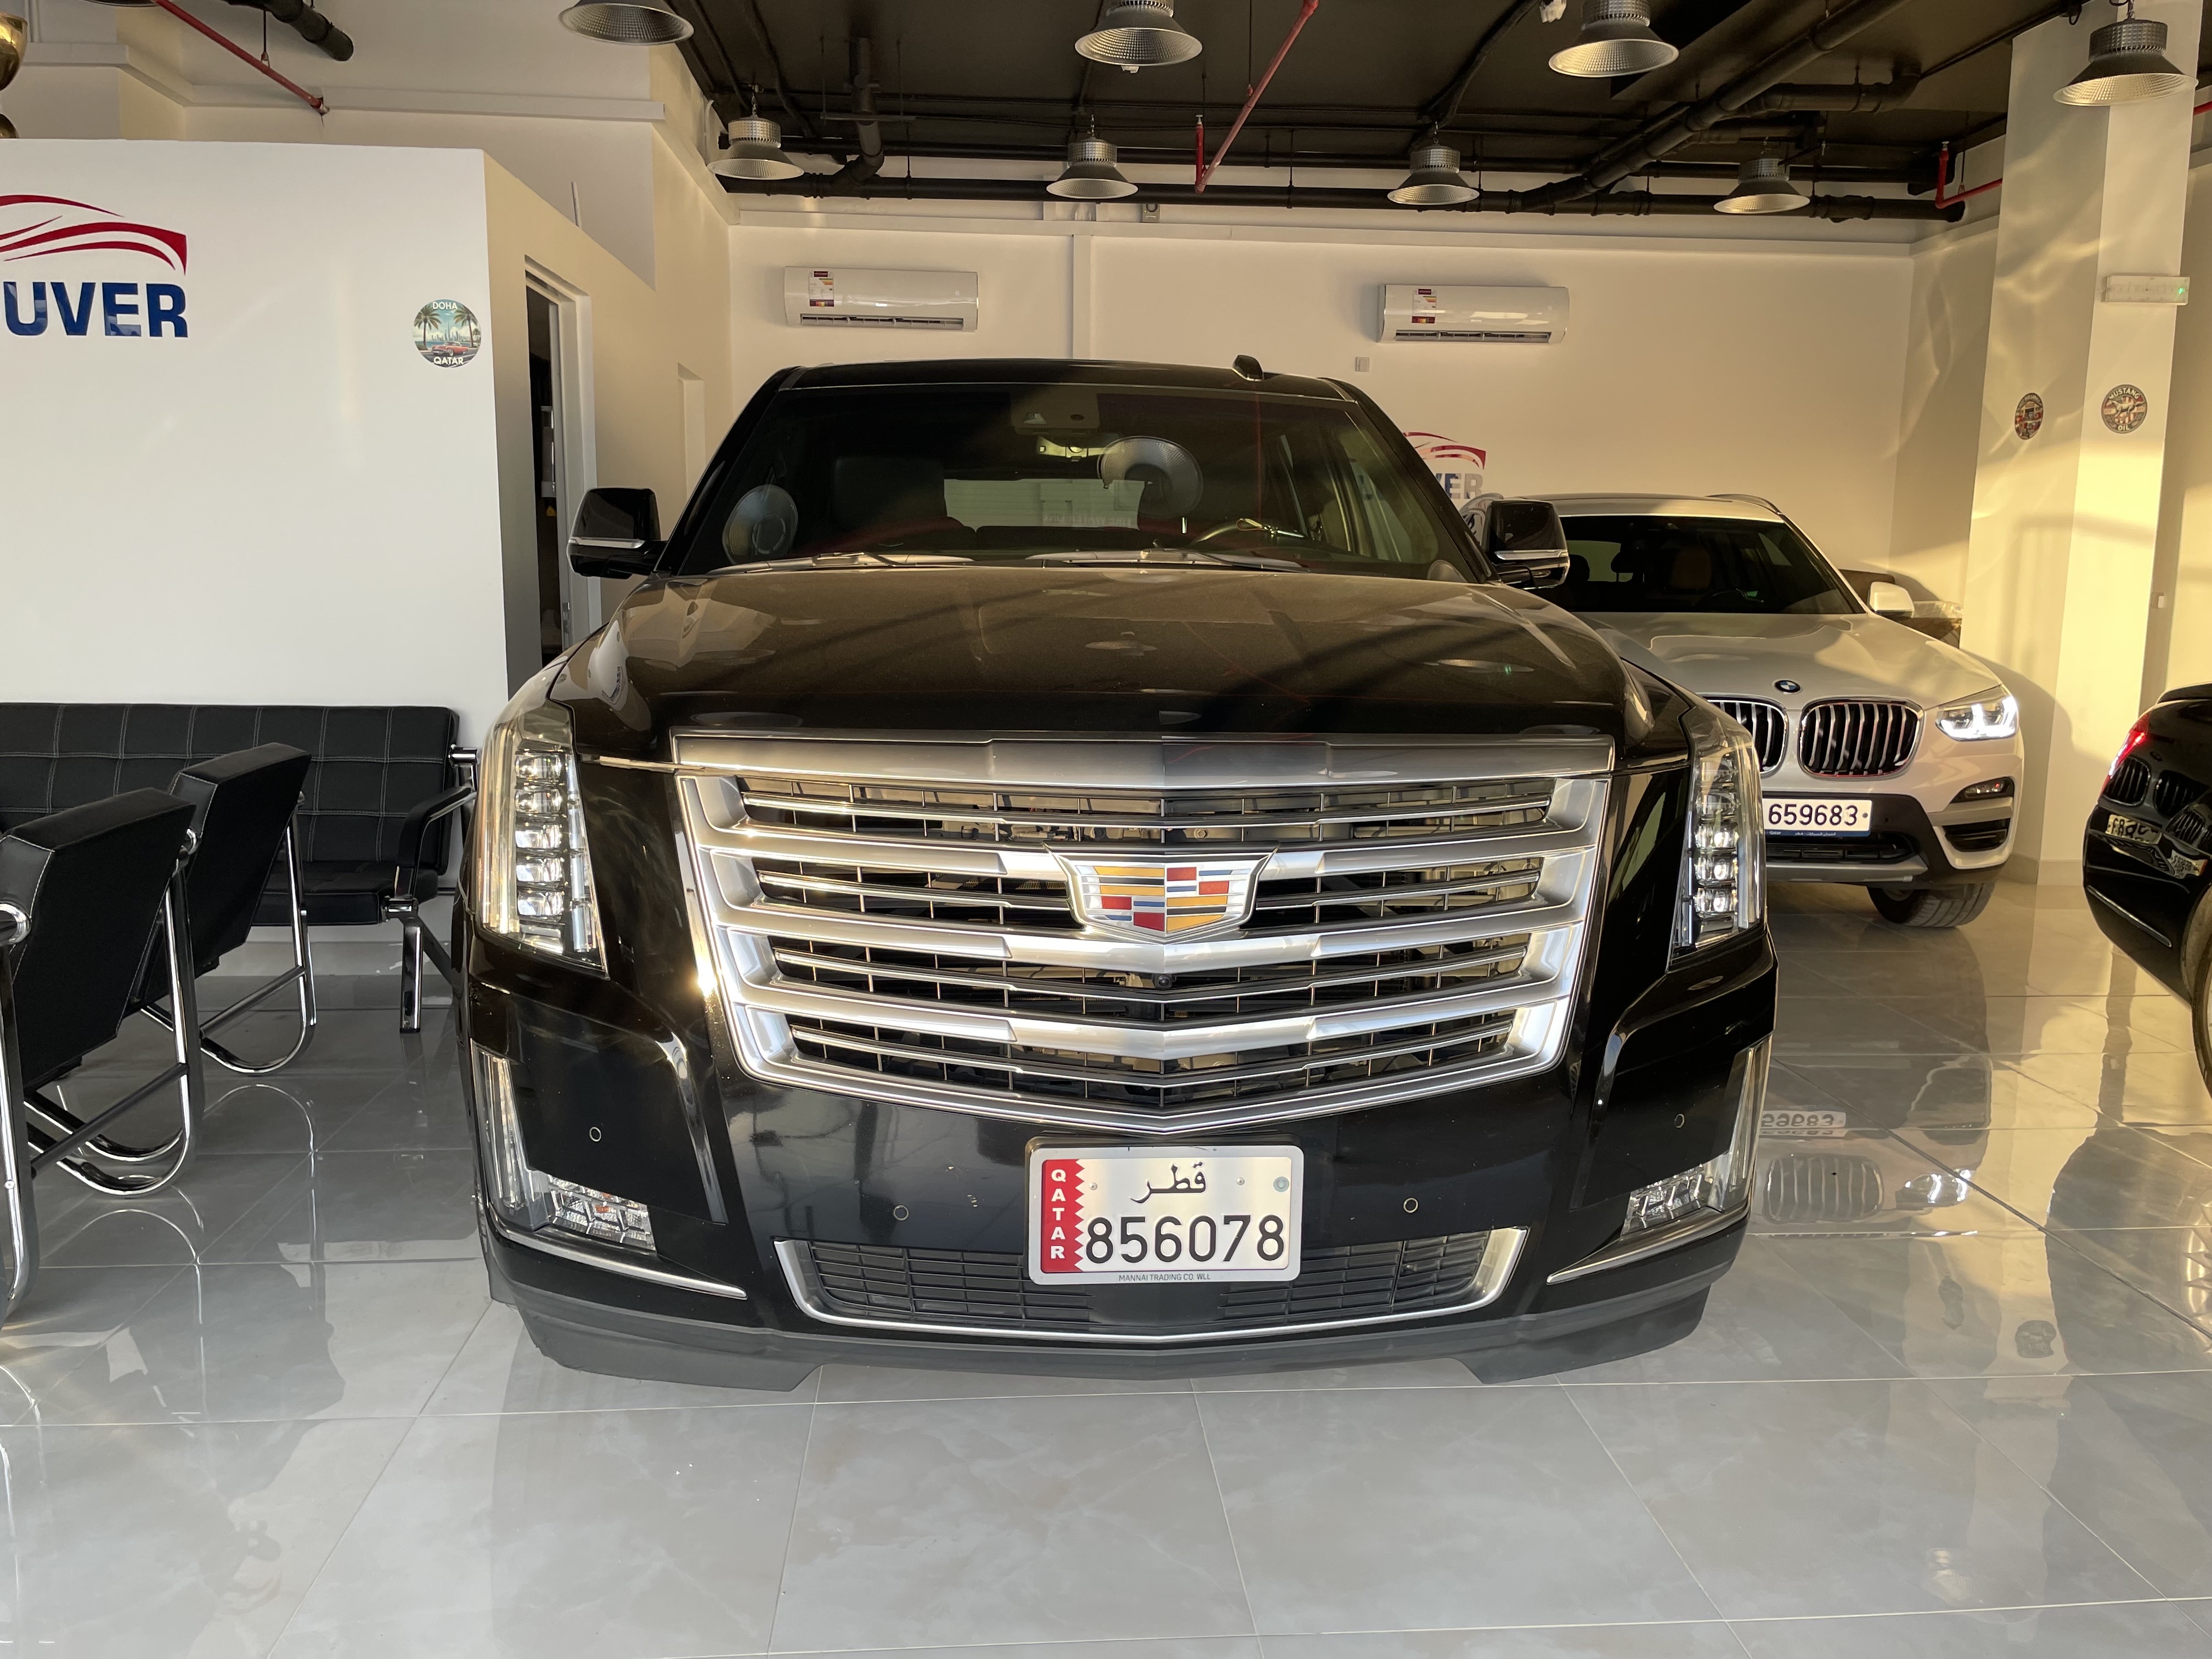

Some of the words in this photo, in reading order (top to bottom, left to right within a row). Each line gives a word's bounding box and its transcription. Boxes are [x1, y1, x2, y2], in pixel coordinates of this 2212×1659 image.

[3, 281, 189, 338] UVER
[432, 301, 458, 310] DOHA
[433, 356, 464, 365] QATAR
[2109, 387, 2140, 399] MUSTANG
[1768, 803, 1858, 826] 659683
[1130, 1160, 1207, 1204] قطر
[1050, 1169, 1066, 1259] QATAR
[1085, 1214, 1284, 1264] 856078
